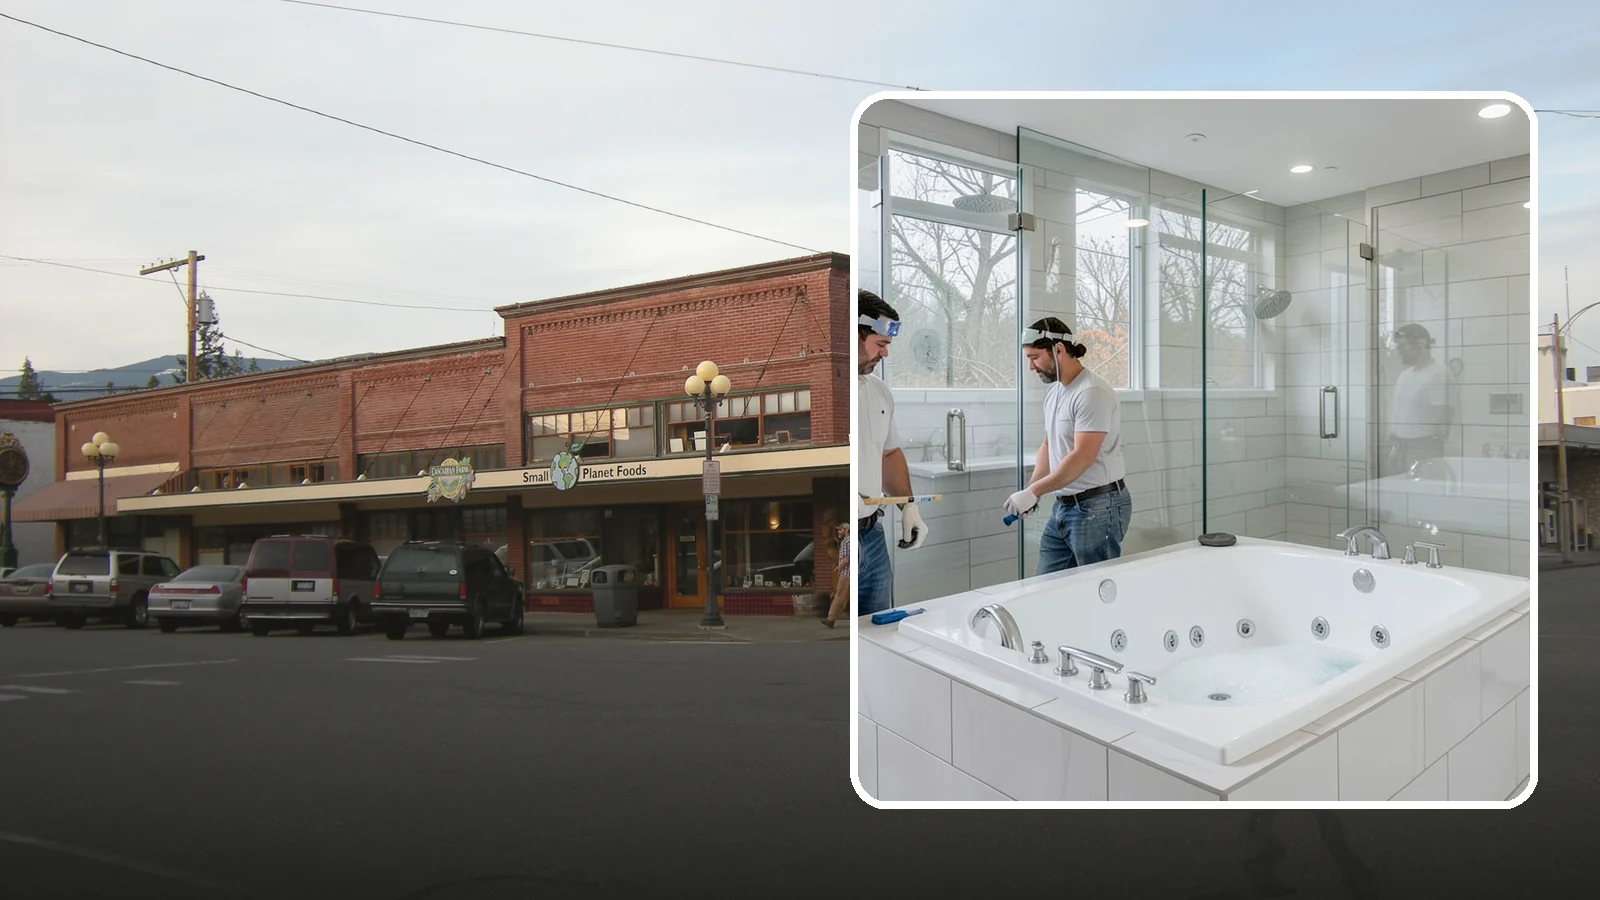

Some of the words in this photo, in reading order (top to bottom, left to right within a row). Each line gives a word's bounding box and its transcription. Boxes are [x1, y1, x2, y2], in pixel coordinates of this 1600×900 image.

[523, 471, 548, 482] Small
[583, 467, 614, 479] Planet
[617, 464, 646, 476] Foods
